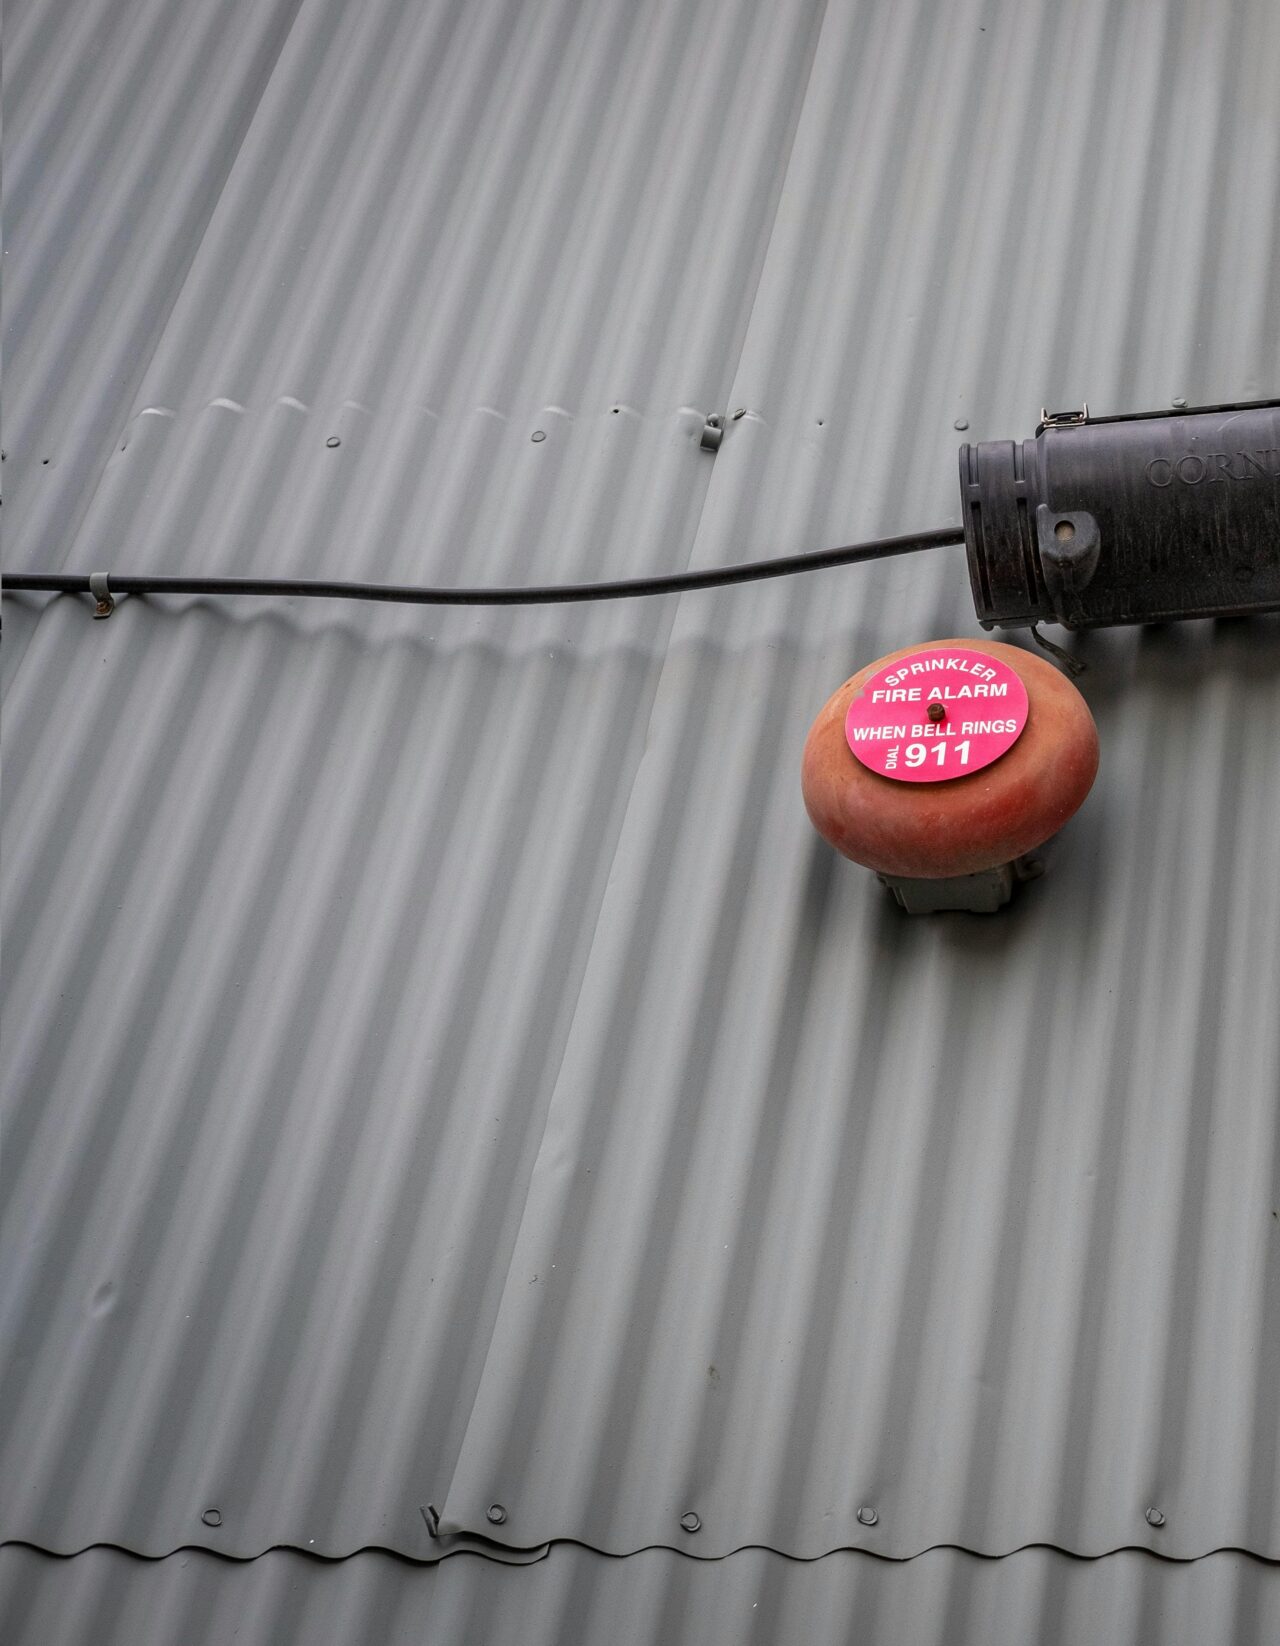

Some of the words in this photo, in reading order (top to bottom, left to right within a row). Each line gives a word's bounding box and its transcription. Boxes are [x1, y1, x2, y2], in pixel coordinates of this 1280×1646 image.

[885, 658, 997, 687] SPRINKLER
[871, 687, 922, 703] FIRE
[927, 683, 1008, 700] ALARM
[853, 725, 906, 741] WHEN
[911, 723, 956, 738] BELL
[961, 719, 1017, 735] RINGS
[885, 745, 899, 769] DIAL
[904, 740, 971, 768] 911
